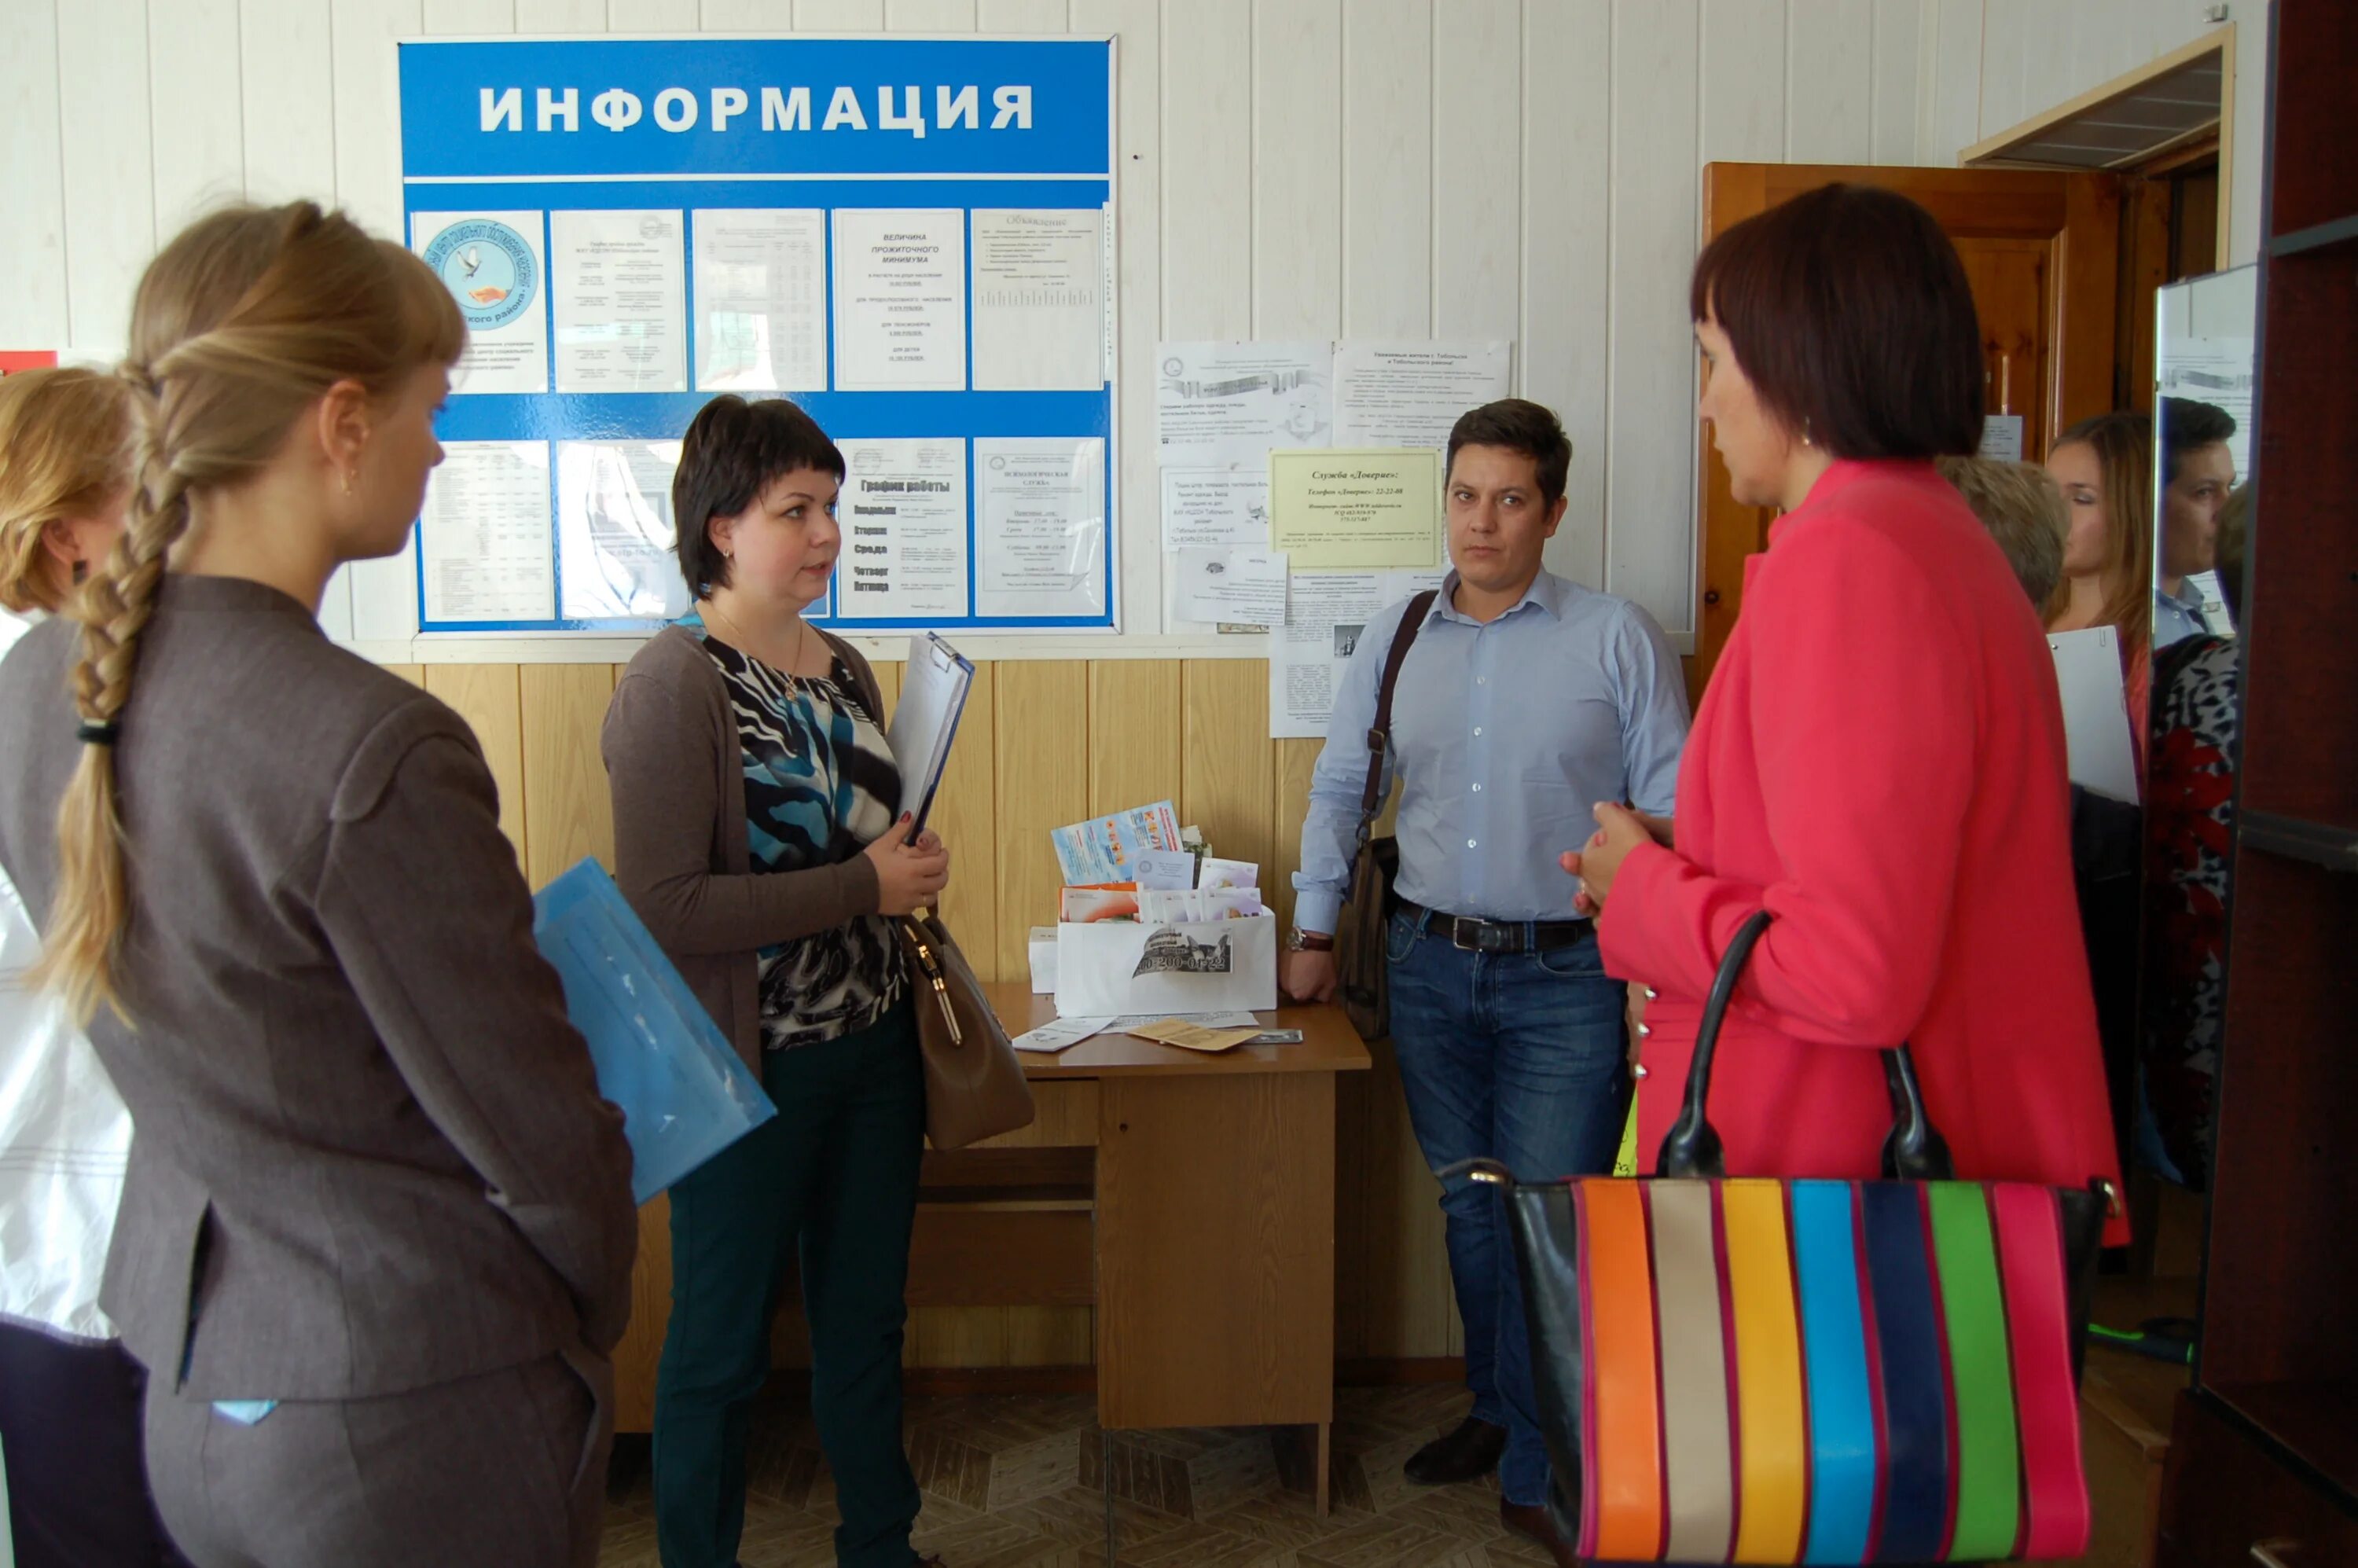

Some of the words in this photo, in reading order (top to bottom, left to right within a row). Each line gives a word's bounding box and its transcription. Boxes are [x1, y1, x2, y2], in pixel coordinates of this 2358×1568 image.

[479, 85, 1034, 138] ИНФОРМАЦИЯ
[1311, 471, 1348, 481] Служба
[1350, 470, 1399, 481] «Доверие»:
[861, 479, 905, 493] График
[906, 480, 950, 493] работы
[854, 544, 888, 555] Среда
[854, 566, 889, 576] Четверг
